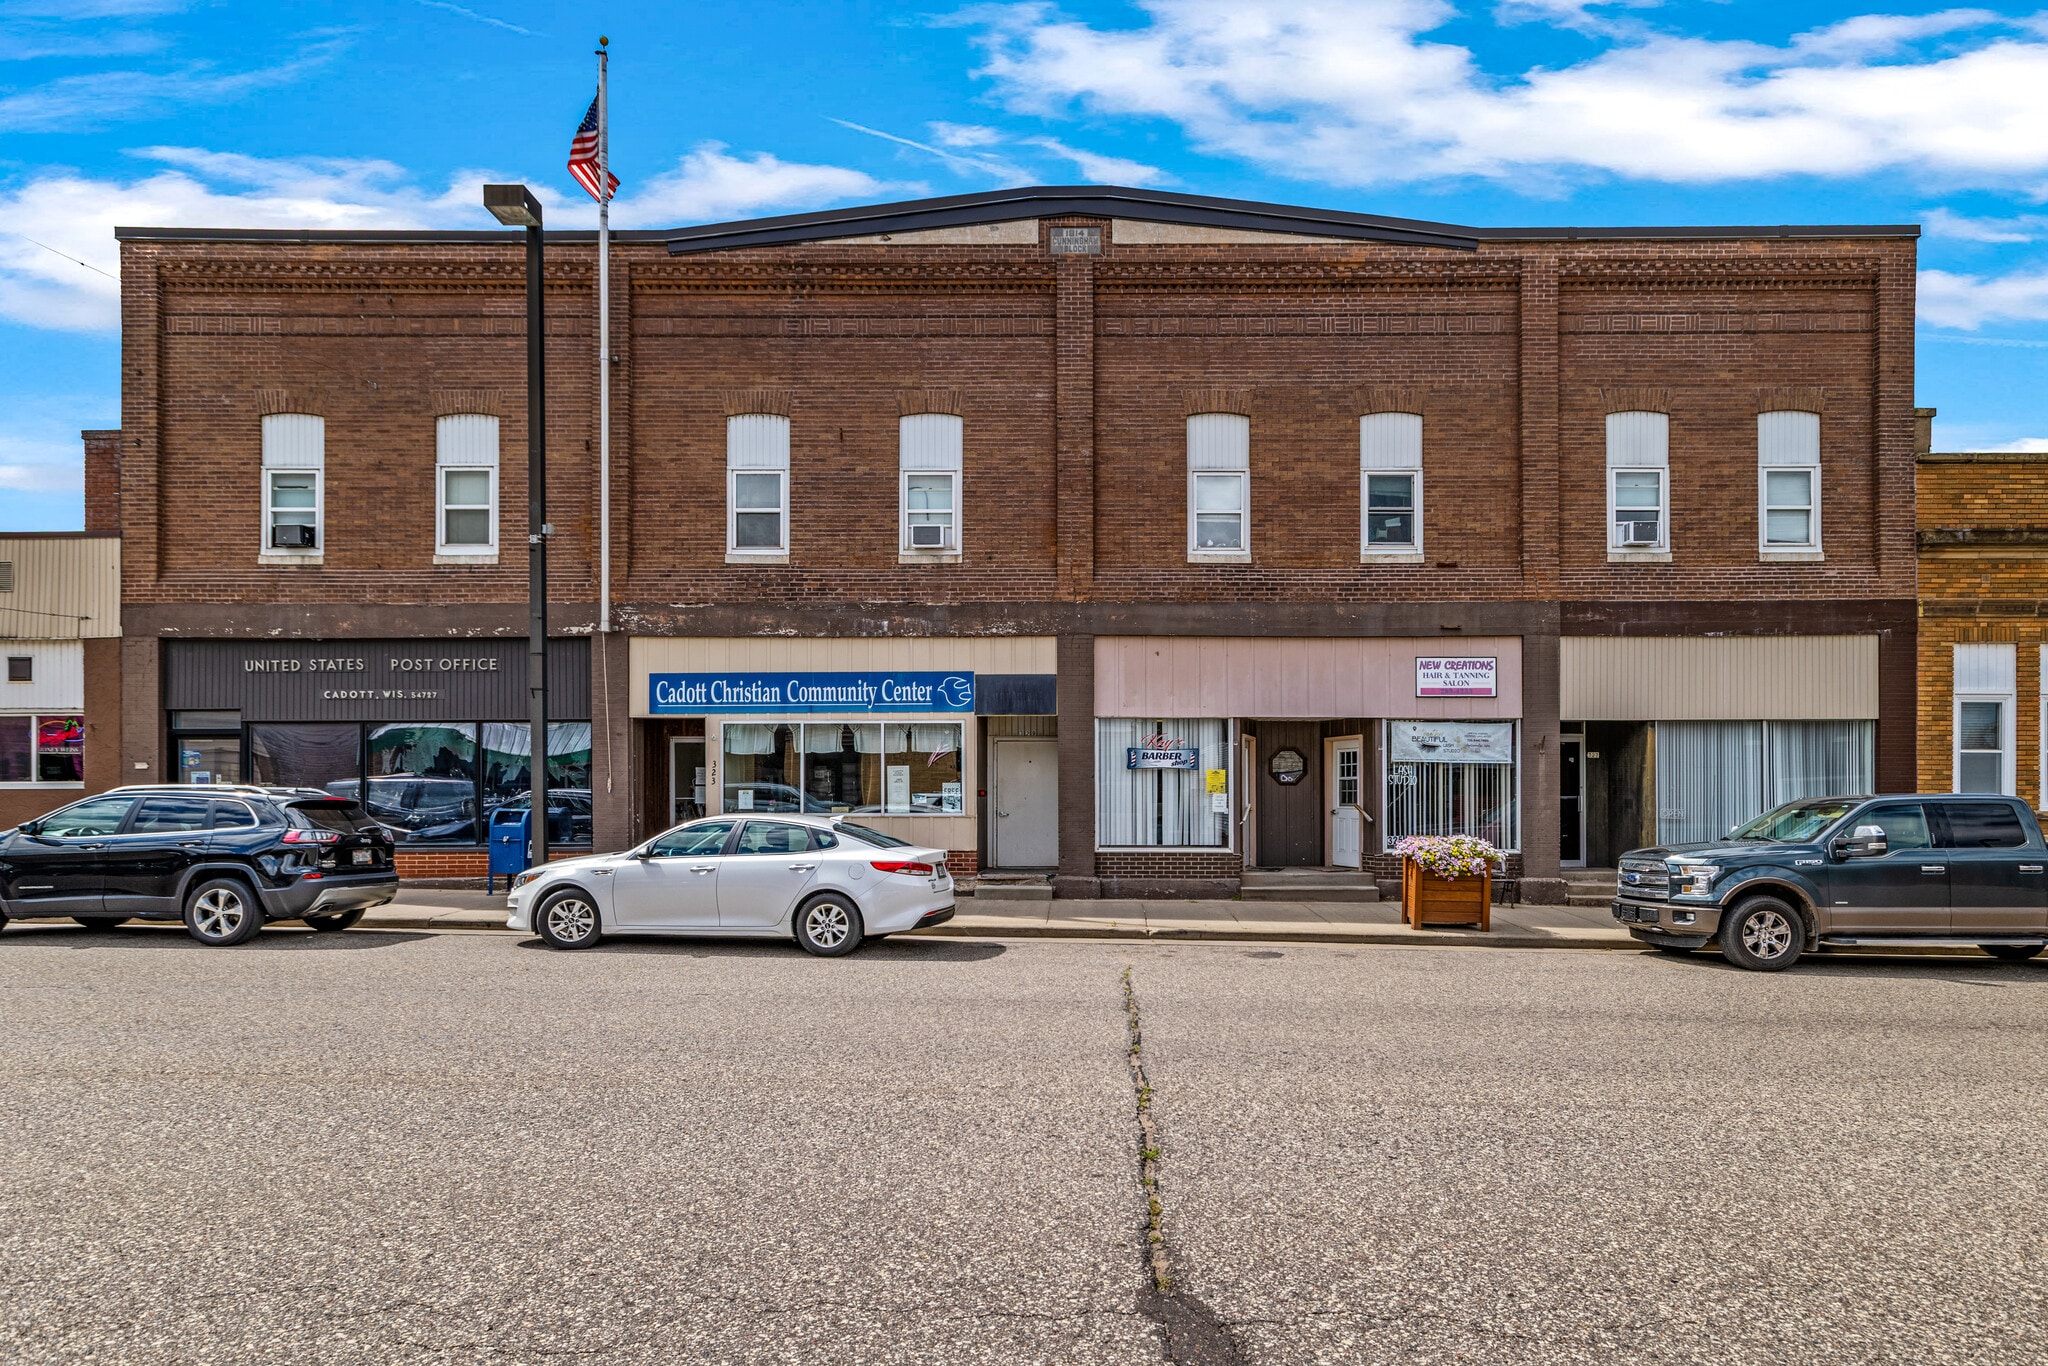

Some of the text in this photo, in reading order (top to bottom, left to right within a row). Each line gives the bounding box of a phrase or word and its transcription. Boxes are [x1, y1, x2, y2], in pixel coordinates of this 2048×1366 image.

[1053, 237, 1098, 245] CUNNINGHAM
[244, 658, 498, 672] UNITED STATES POST OFFICE
[1419, 660, 1494, 671] NEW CREATIONS
[382, 690, 407, 699] WIS.
[411, 691, 438, 699] 54727
[656, 679, 933, 709] Cadott Christian Community Center
[1141, 752, 1182, 760] BARBER
[1170, 759, 1188, 767] shop
[1393, 764, 1413, 775] LASH
[1387, 774, 1418, 785] STUDIO
[1662, 810, 1684, 818] OPEN
